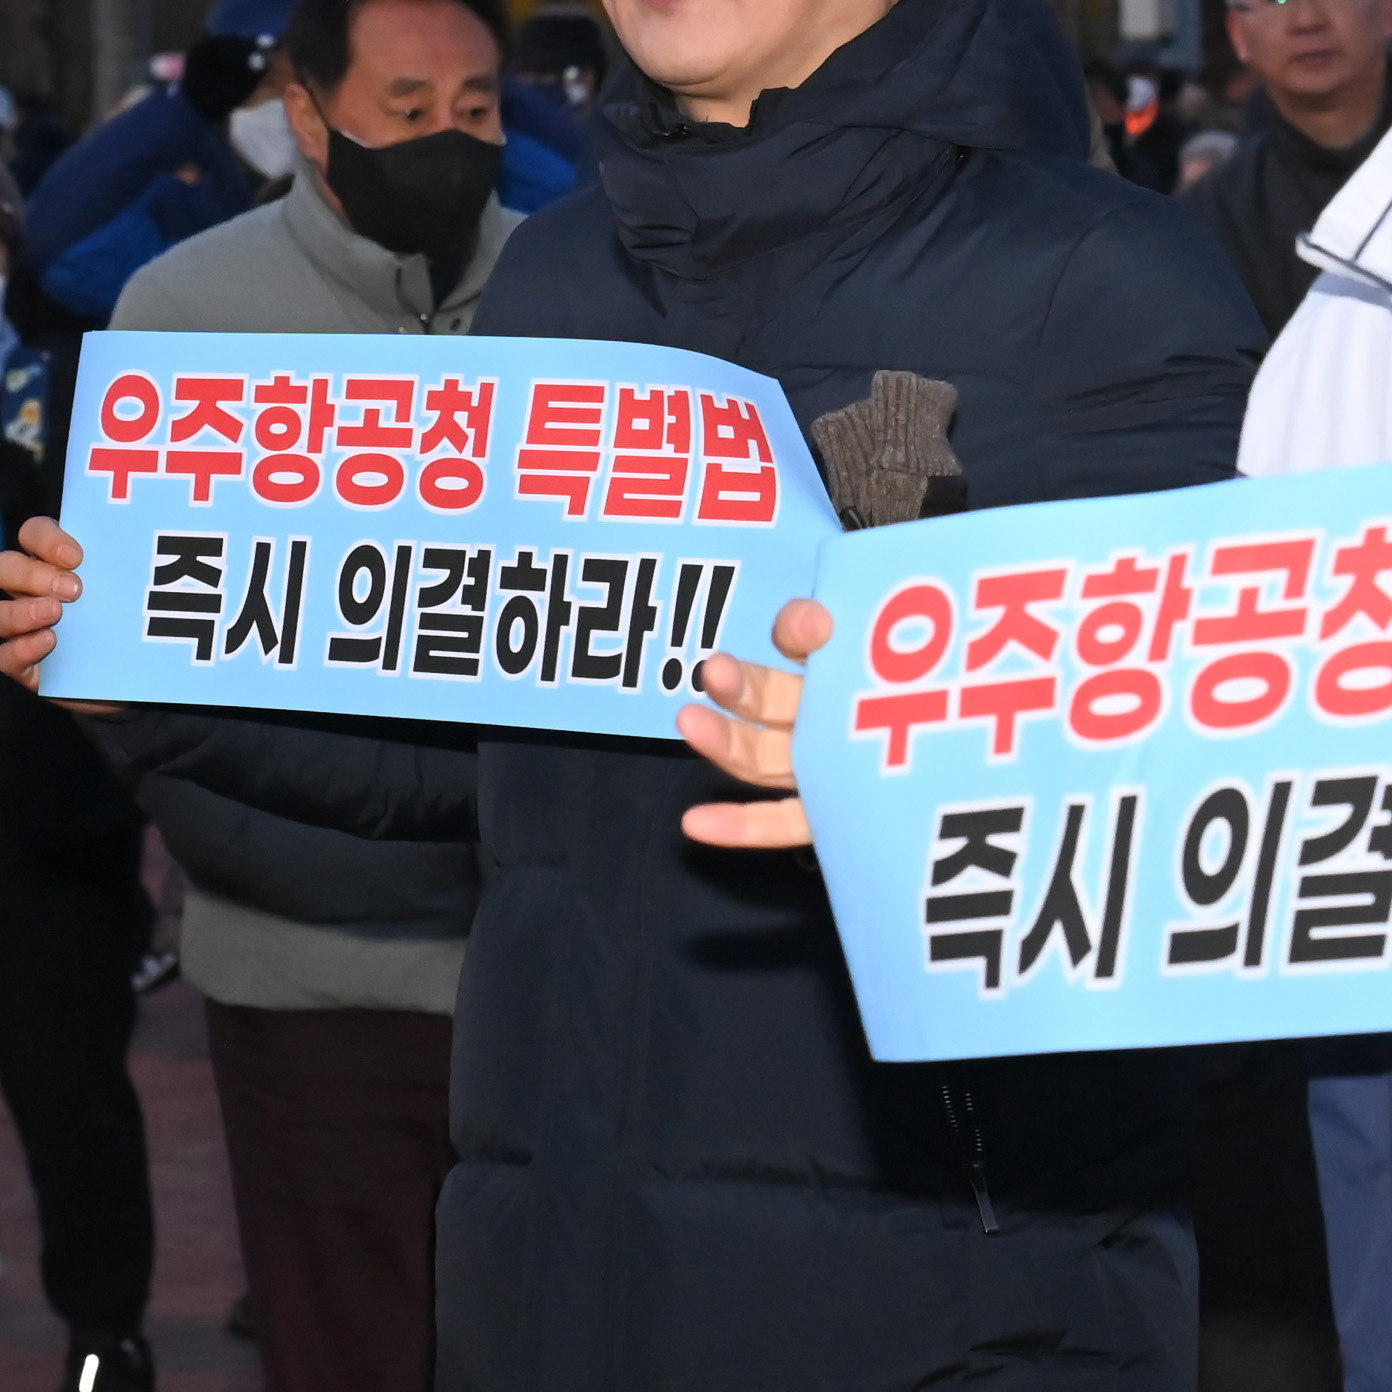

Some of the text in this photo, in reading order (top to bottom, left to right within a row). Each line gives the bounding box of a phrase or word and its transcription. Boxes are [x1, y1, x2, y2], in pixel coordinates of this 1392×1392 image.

[90, 374, 777, 523] 우주항공청 특별법
[146, 535, 736, 693] 즉시 의결하라!!
[925, 795, 1137, 989] 즉시
